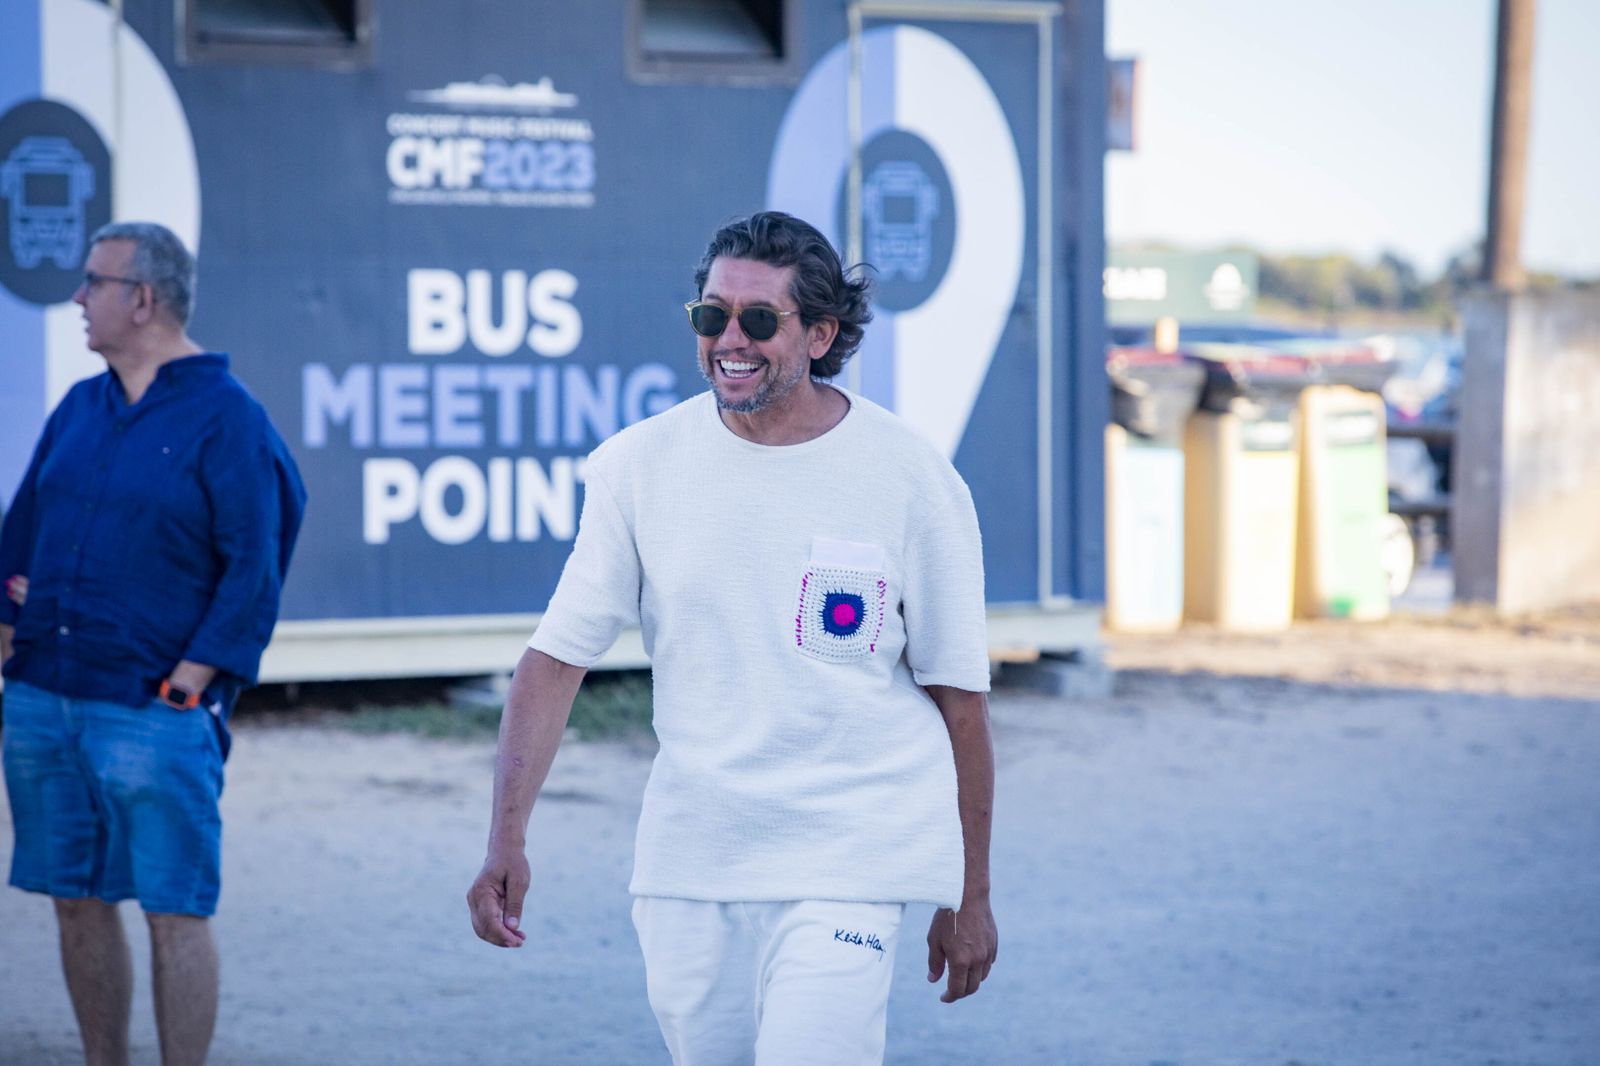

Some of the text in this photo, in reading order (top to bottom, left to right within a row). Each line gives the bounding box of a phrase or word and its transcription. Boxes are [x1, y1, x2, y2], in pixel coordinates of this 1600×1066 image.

[386, 135, 595, 190] CMF2023
[407, 268, 583, 358] BUS
[362, 455, 588, 545] POIN
[834, 929, 864, 946] Keith
